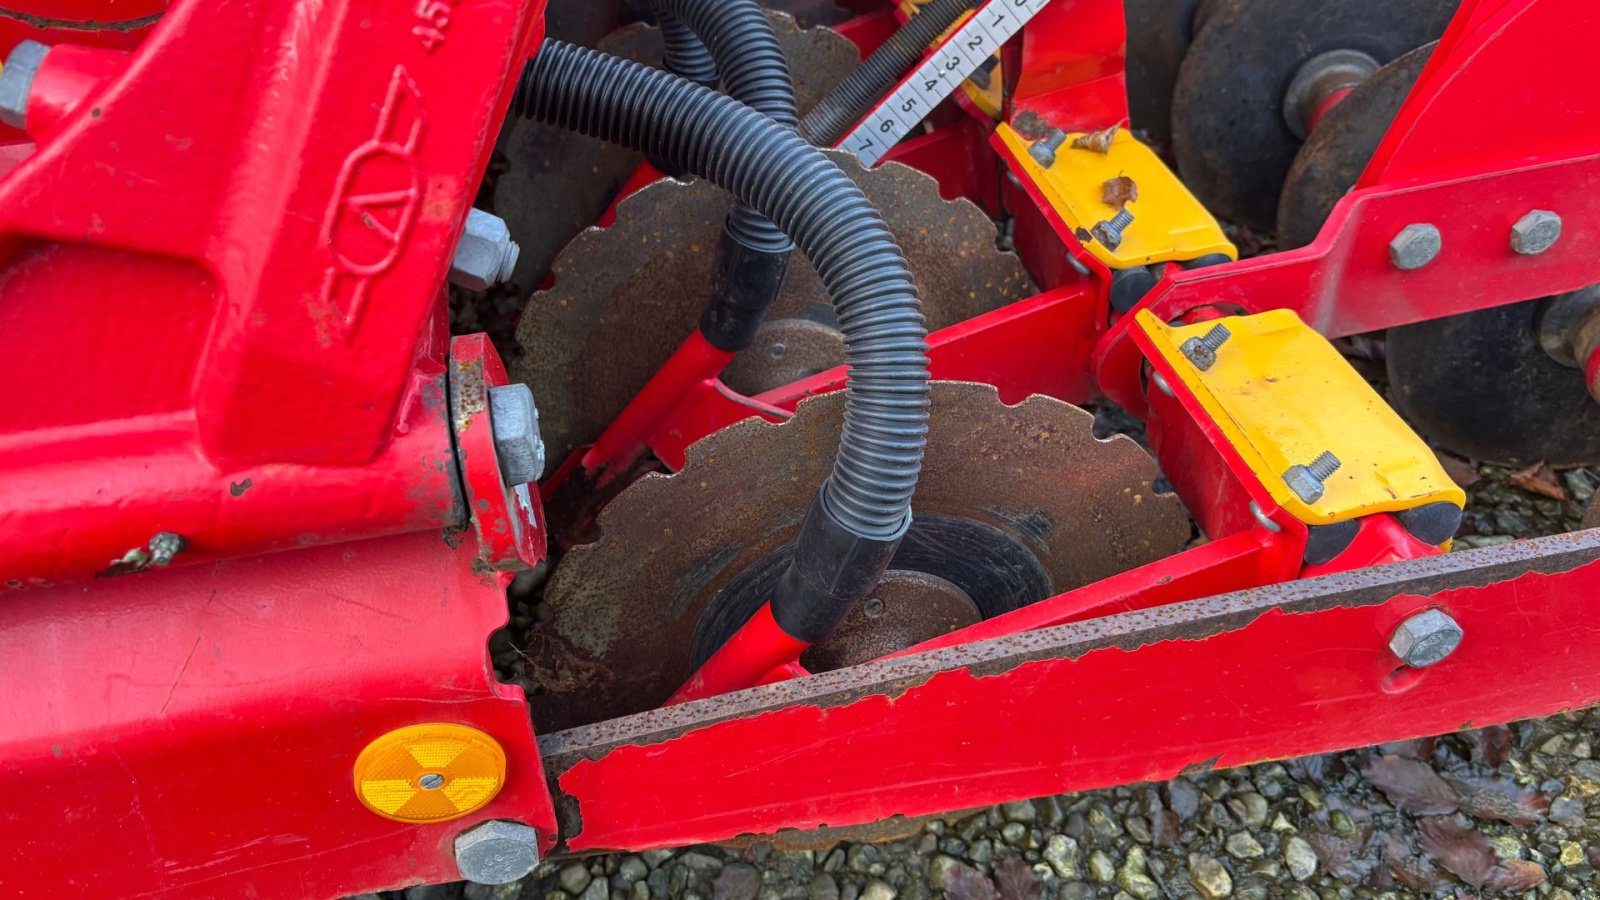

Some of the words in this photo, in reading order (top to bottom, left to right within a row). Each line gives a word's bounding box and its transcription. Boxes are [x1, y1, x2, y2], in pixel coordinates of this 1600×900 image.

[992, 14, 1005, 27] 1
[967, 35, 983, 51] 2
[945, 56, 960, 71] 3
[925, 79, 938, 92] 4
[902, 98, 917, 112] 5
[880, 119, 894, 133] 6
[859, 138, 874, 151] 7
